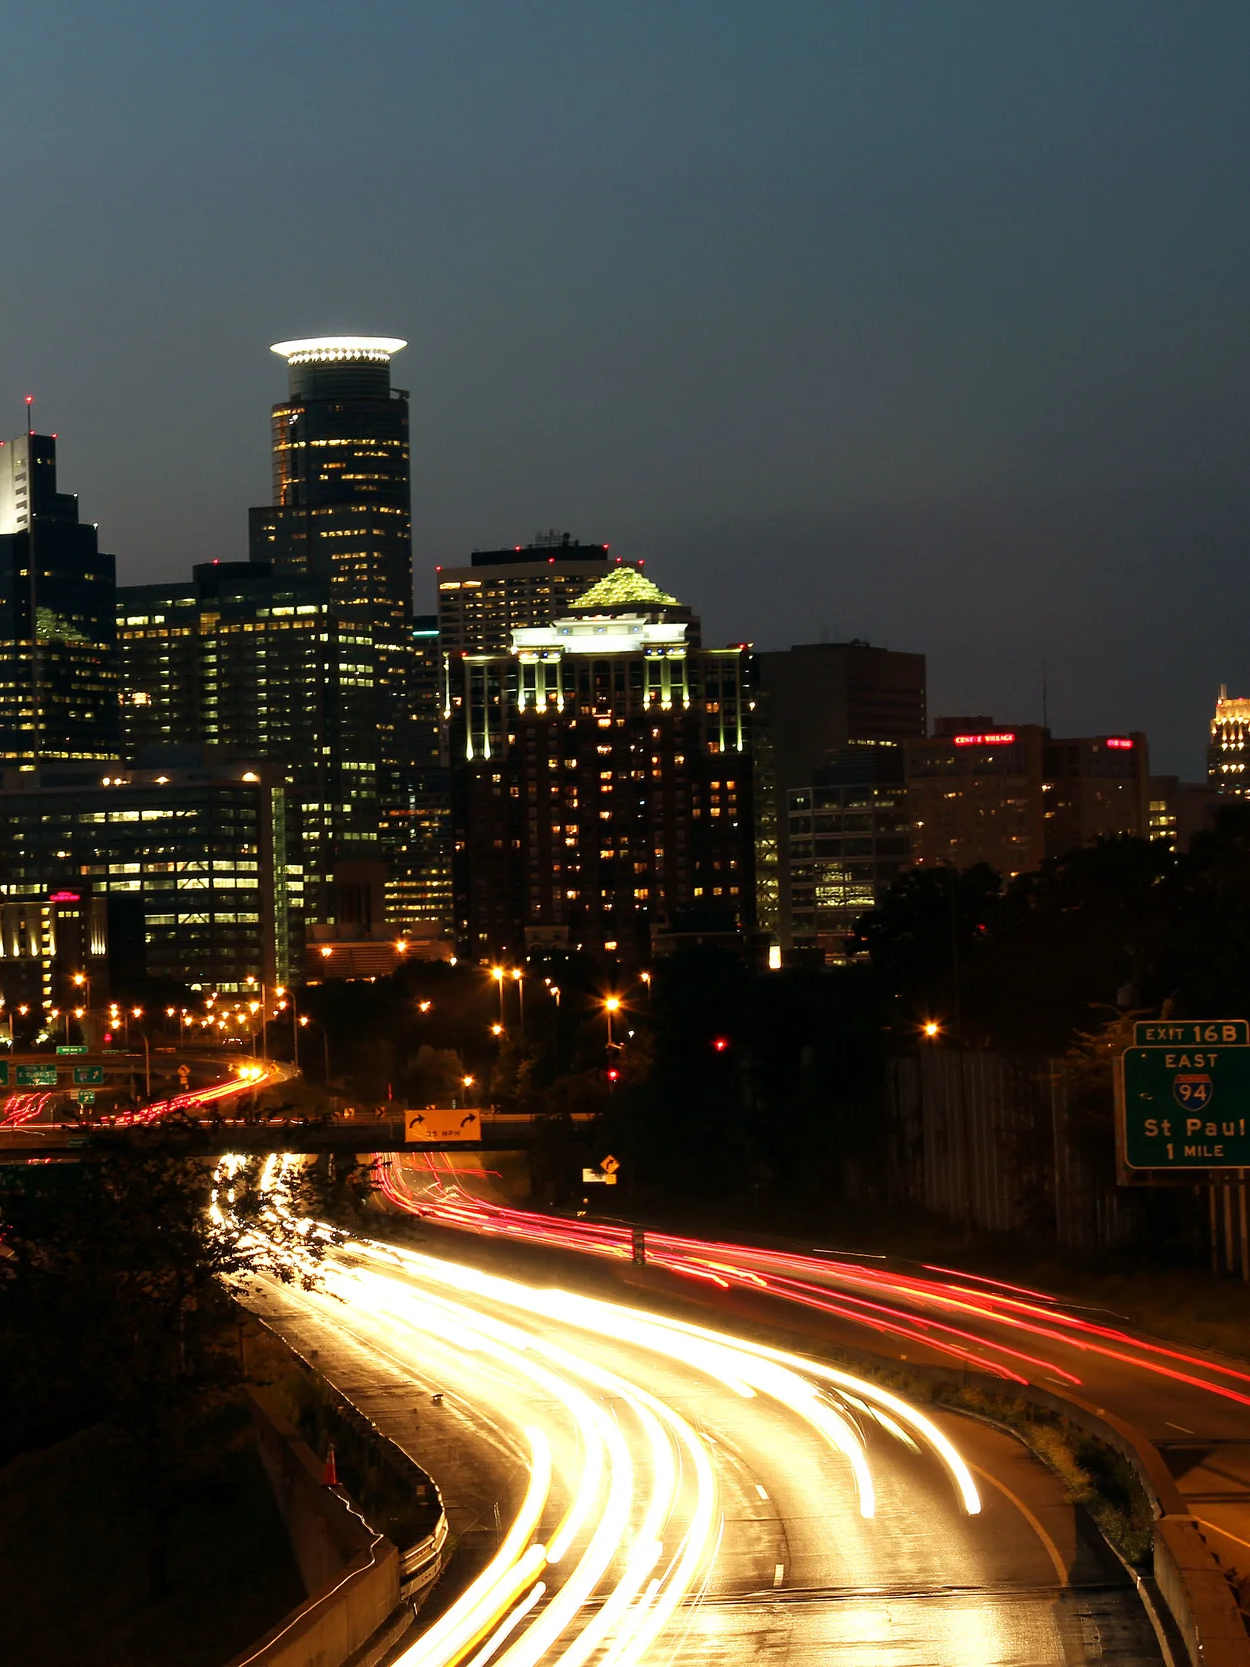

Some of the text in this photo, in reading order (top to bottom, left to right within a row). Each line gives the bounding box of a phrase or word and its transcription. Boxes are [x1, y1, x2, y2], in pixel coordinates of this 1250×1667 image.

[1146, 1025, 1237, 1042] EXIT 16B
[1166, 1054, 1218, 1068] EAST
[1179, 1084, 1207, 1101] 94
[1144, 1118, 1245, 1137] St Paul
[1166, 1143, 1224, 1160] 1 MILE
